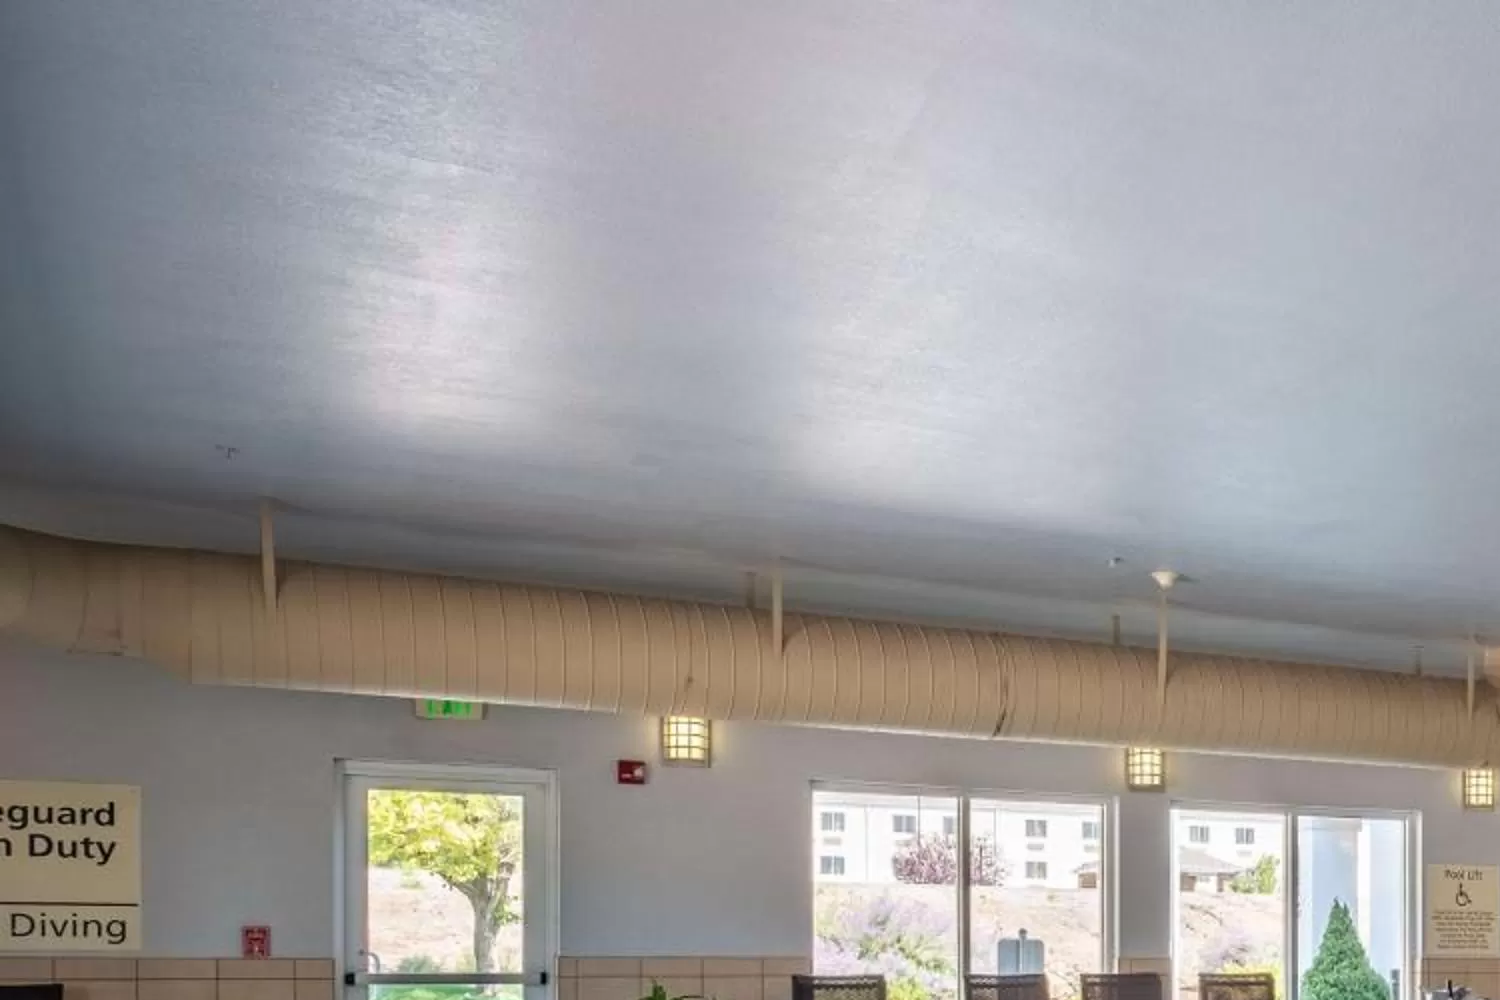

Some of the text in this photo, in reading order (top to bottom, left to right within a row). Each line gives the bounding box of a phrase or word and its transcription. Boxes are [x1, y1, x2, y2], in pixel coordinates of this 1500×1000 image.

[0, 801, 115, 831] guard
[28, 833, 116, 866] Duty
[10, 912, 127, 945] Diving
